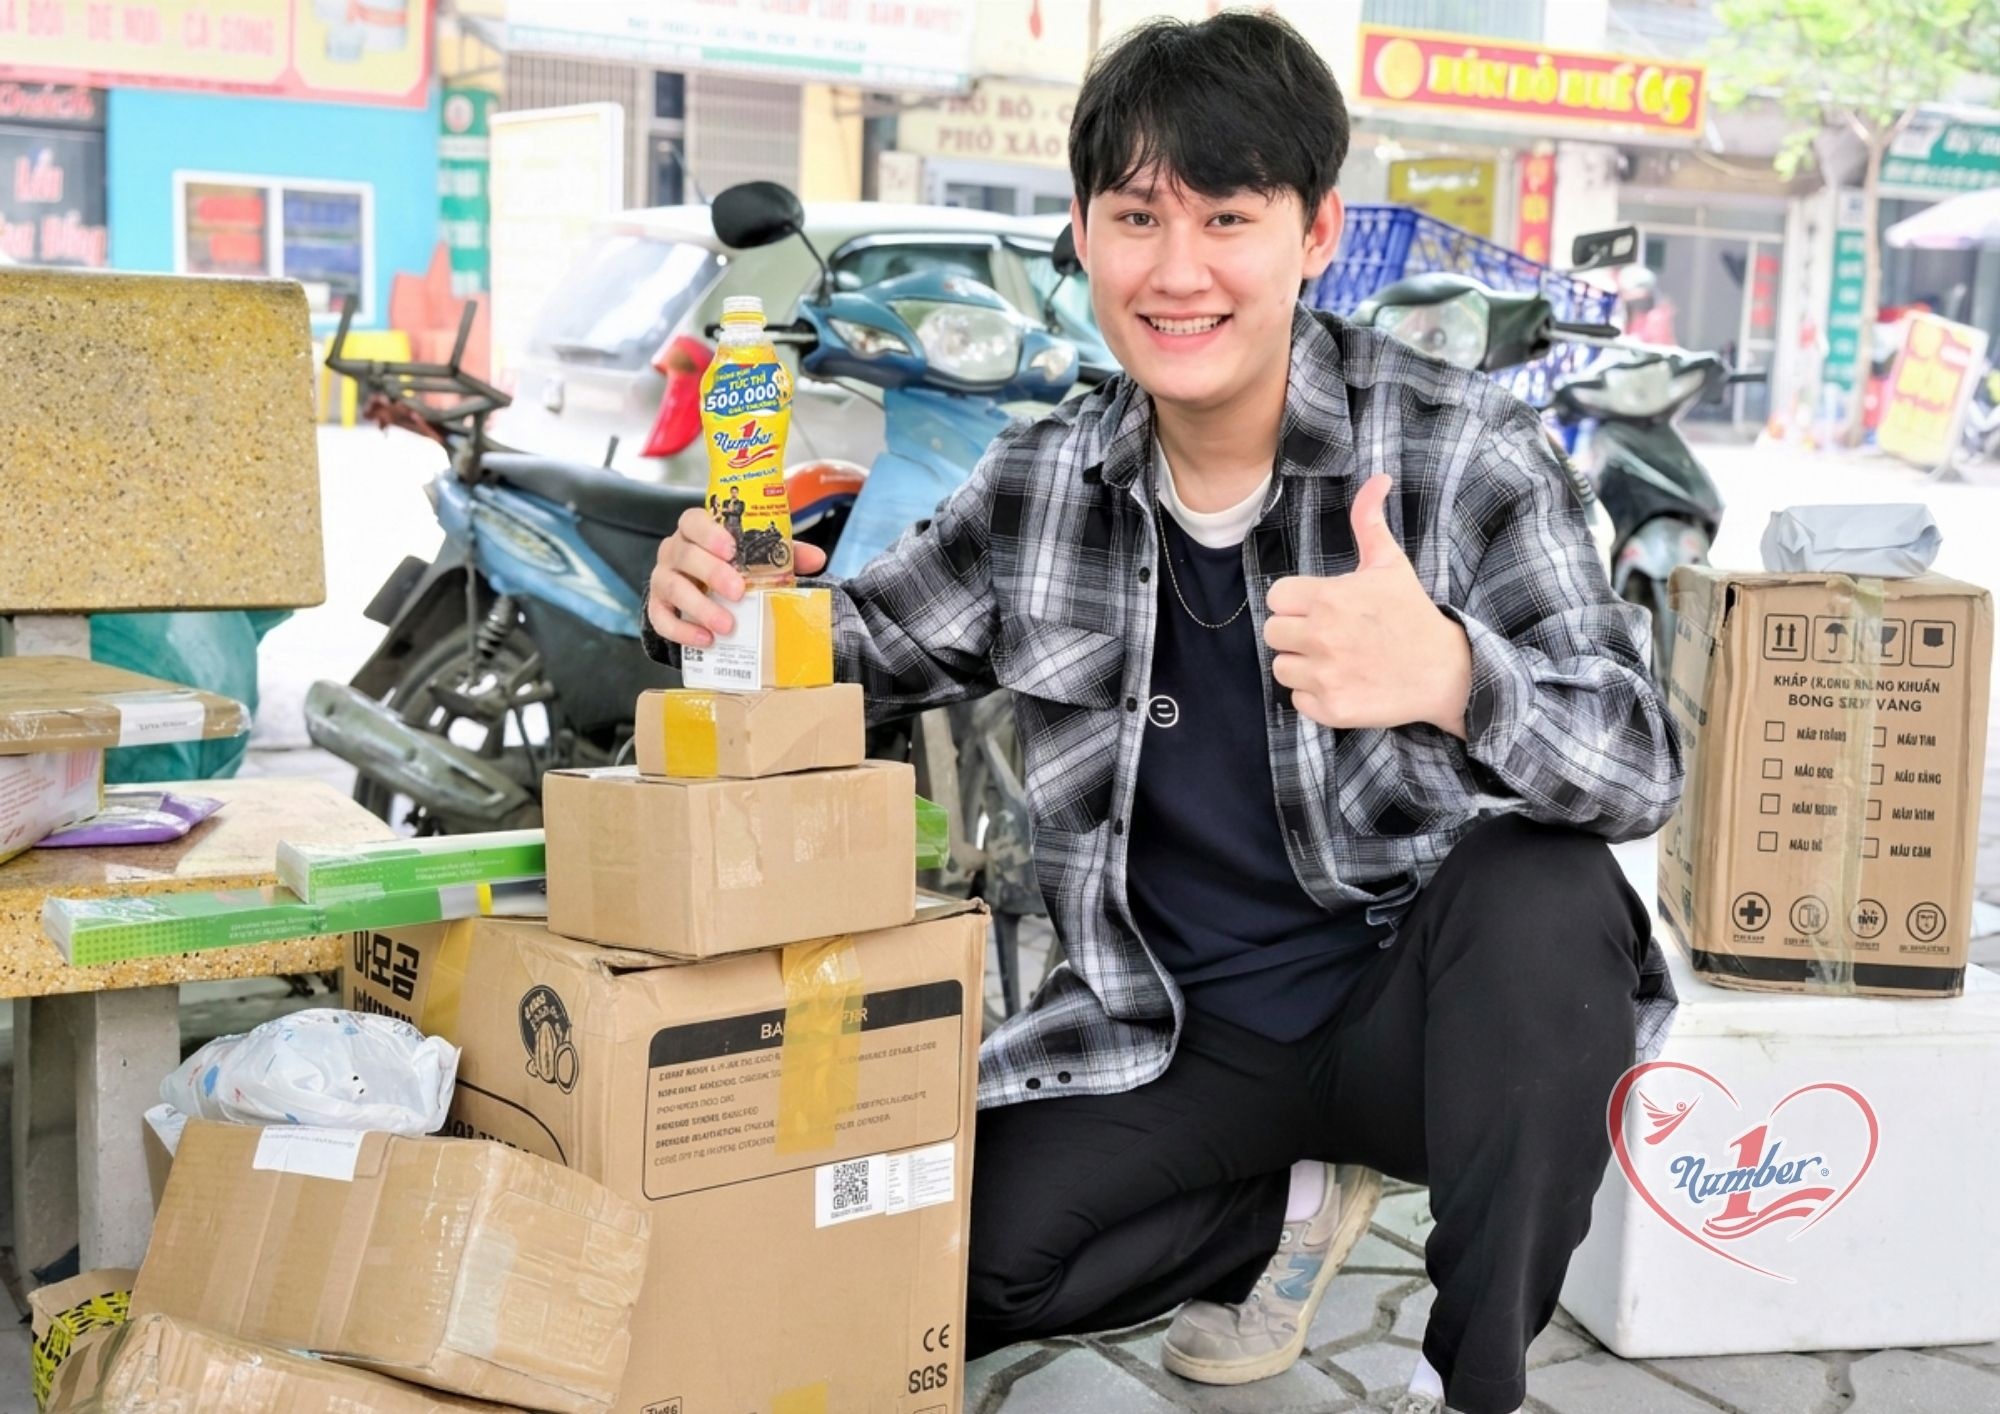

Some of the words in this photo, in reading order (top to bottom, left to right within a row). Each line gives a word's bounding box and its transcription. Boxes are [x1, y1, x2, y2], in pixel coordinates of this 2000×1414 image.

[706, 383, 776, 411] 500.000
[714, 427, 773, 453] Number
[922, 1323, 951, 1353] CE
[907, 1361, 949, 1395] SGS
